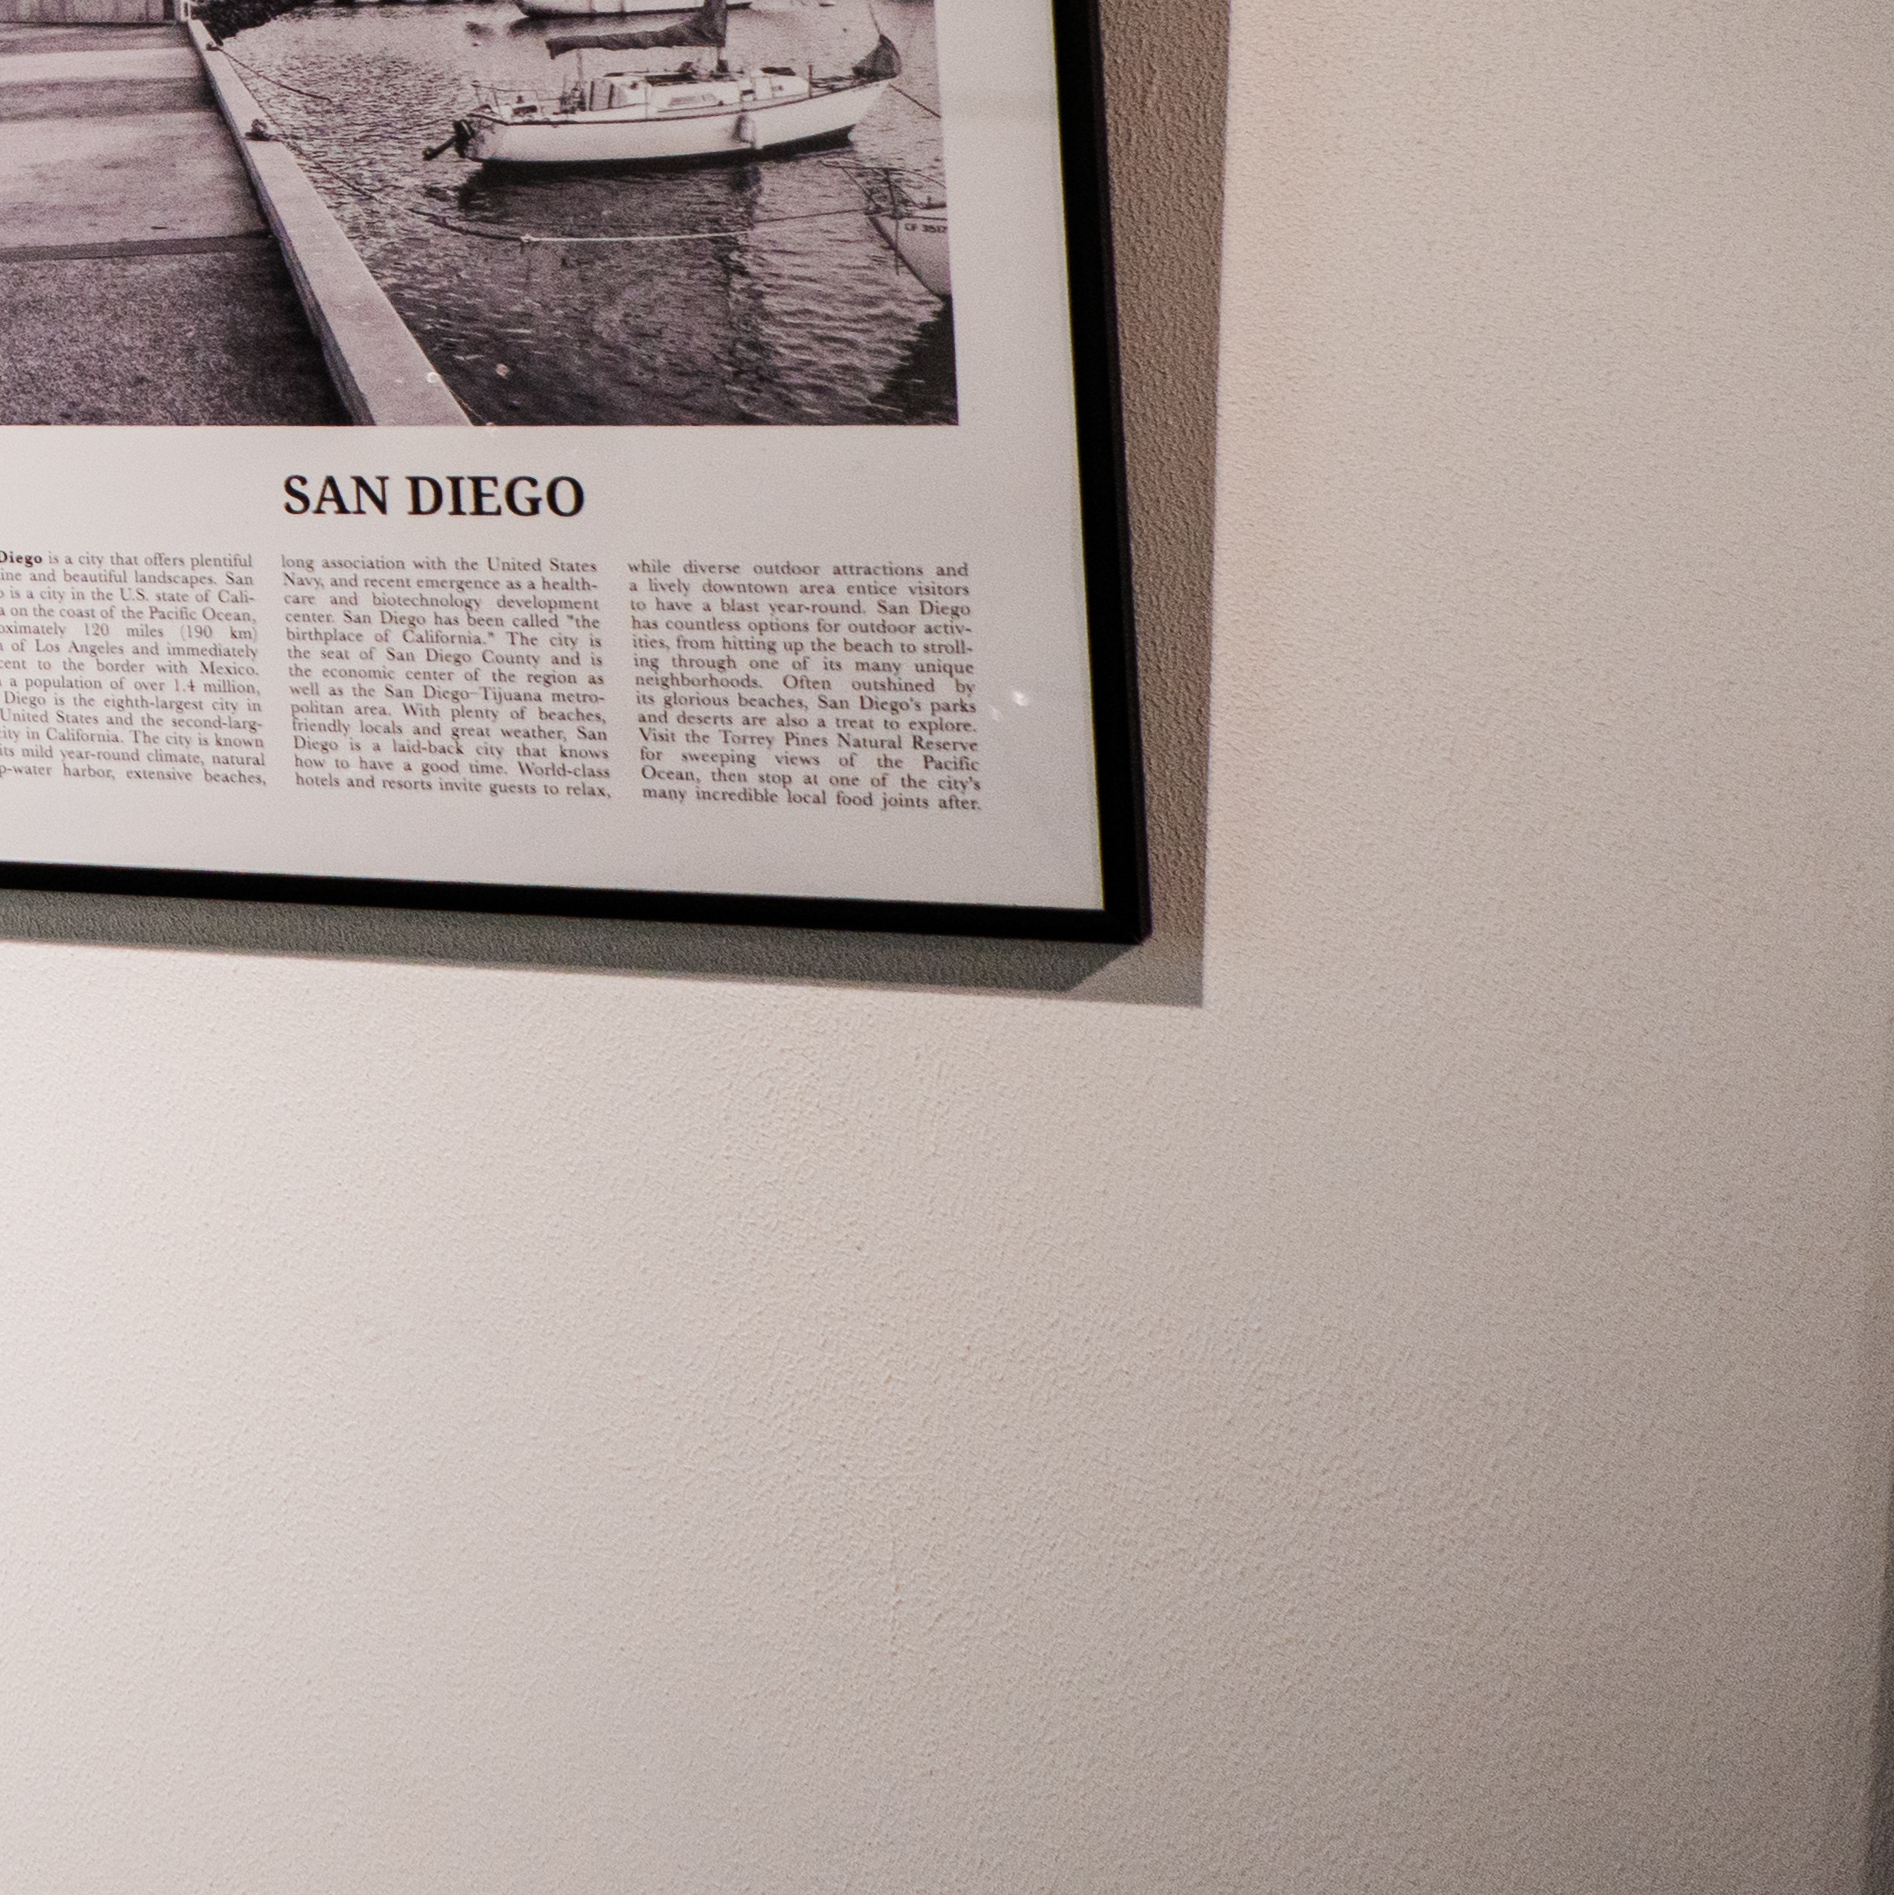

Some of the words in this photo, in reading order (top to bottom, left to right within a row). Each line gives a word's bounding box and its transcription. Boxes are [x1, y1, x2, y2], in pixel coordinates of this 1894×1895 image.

[284, 474, 390, 515] SAN
[405, 474, 585, 518] DIEGO
[47, 550, 59, 564] is
[63, 554, 73, 565] a
[77, 550, 104, 569] city
[109, 551, 138, 566] that
[143, 552, 185, 567] offers
[189, 553, 253, 573] plentiful
[280, 552, 314, 572] long
[320, 553, 406, 570] association
[411, 554, 447, 571] with
[453, 555, 479, 571] the
[486, 556, 542, 573] United
[548, 557, 597, 574] States
[626, 557, 671, 573] while
[681, 557, 741, 574] diverse
[751, 559, 821, 575] outdoor
[831, 560, 924, 577] attractions
[934, 561, 969, 578] and
[28, 567, 56, 582] and
[62, 568, 128, 584] beautiful
[133, 569, 217, 590] landscapes.
[224, 571, 254, 587] San
[282, 570, 325, 591] Navy,
[328, 571, 358, 587] and
[362, 574, 411, 588] recent
[415, 577, 501, 594] emergence
[505, 579, 522, 591] as
[526, 579, 536, 591] a
[540, 576, 598, 592] health-
[627, 580, 638, 591] a
[647, 576, 691, 596] lively
[700, 577, 788, 594] downtown
[798, 583, 836, 595] area
[845, 579, 897, 596] entice
[907, 580, 970, 597] visitors
[9, 584, 21, 599] is
[25, 588, 34, 599] a
[38, 585, 65, 604] city
[70, 586, 85, 600] in
[90, 586, 113, 601] the
[119, 587, 149, 602] U.S.
[155, 590, 189, 603] state
[194, 589, 209, 604] of
[216, 589, 255, 605] Cali-
[282, 593, 316, 605] care
[328, 589, 358, 605] and
[371, 590, 482, 613] biotechnology
[495, 593, 599, 615] development
[9, 606, 28, 617] on
[31, 602, 54, 617] the
[58, 605, 96, 619] coast
[99, 604, 114, 619] of
[120, 605, 144, 620] the
[148, 605, 196, 621] Pacific
[200, 607, 256, 625] Ocean,
[342, 608, 372, 624] San
[379, 609, 427, 630] Diego
[432, 610, 460, 626] has
[465, 611, 505, 627] been
[510, 612, 559, 629] called
[629, 597, 647, 611] to
[654, 595, 693, 611] have
[701, 600, 712, 612] a
[719, 596, 760, 613] blast
[767, 597, 866, 619] year-round.
[876, 599, 910, 616] San
[918, 600, 971, 621] Diego
[84, 621, 110, 637] 120
[125, 623, 164, 638] miles
[179, 624, 213, 644] (190
[229, 625, 257, 644] km)
[630, 613, 659, 630] has
[663, 614, 741, 631] countless
[746, 616, 810, 637] options
[815, 617, 841, 633] for
[846, 618, 917, 635] outdoor
[922, 619, 972, 636] activ-
[10, 637, 27, 652] of
[34, 638, 60, 653] Los
[67, 639, 124, 659] Angeles
[130, 640, 160, 656] and
[166, 642, 258, 663] immediately
[285, 625, 364, 646] birthplace
[373, 627, 392, 643] of
[505, 630, 539, 647] The
[548, 631, 579, 652] city
[588, 632, 602, 648] is
[631, 632, 670, 651] ities,
[675, 633, 715, 650] from
[720, 634, 777, 655] hitting
[782, 640, 805, 656] up
[809, 636, 837, 652] the
[842, 637, 894, 654] beach
[899, 640, 917, 654] to
[922, 639, 973, 655] stroll-
[286, 643, 311, 659] the
[319, 646, 350, 660] seat
[358, 645, 374, 661] of
[385, 646, 415, 662] San
[424, 647, 472, 668] Diego
[480, 648, 541, 669] County
[549, 650, 581, 666] and
[589, 651, 603, 667] is
[632, 651, 660, 672] ing
[670, 652, 737, 673] through
[747, 658, 780, 670] one
[790, 655, 810, 671] of
[822, 656, 843, 672] its
[854, 661, 902, 677] many
[913, 658, 975, 679] unique
[287, 662, 312, 678] the
[320, 663, 395, 680] economic
[404, 667, 455, 682] center
[462, 666, 481, 682] of
[490, 667, 516, 683] the
[525, 668, 578, 689] region
[586, 674, 605, 686] as
[633, 670, 763, 693] neighborhoods.
[781, 674, 832, 691] Often
[850, 675, 935, 693] outshined
[954, 678, 976, 698] by
